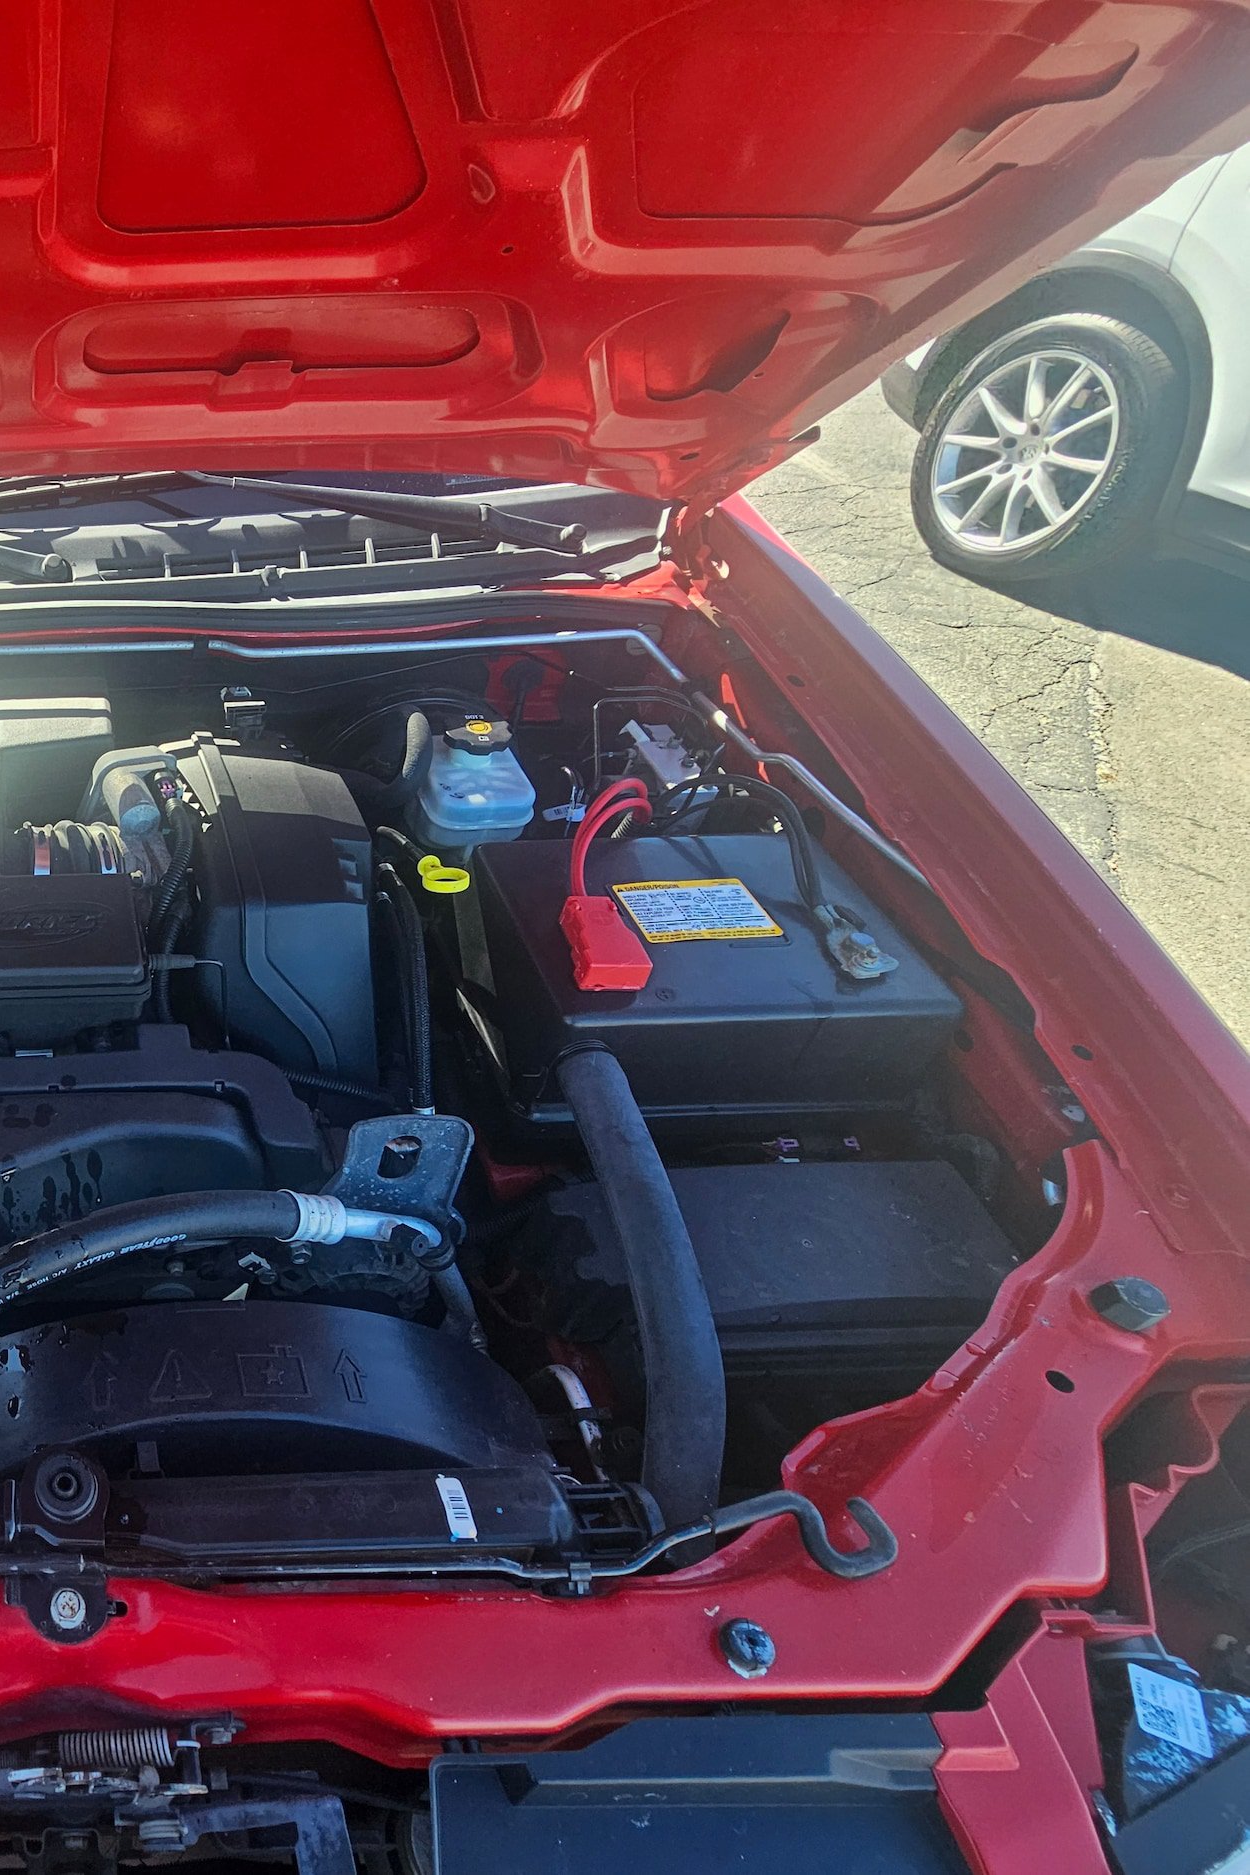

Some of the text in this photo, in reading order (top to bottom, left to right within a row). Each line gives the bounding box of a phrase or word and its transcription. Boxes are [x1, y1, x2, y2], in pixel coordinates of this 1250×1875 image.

[120, 1233, 187, 1255] GOODYEAR
[74, 1251, 115, 1270] GALAXY
[51, 1267, 68, 1279] A/C
[26, 1276, 50, 1290] HOSE
